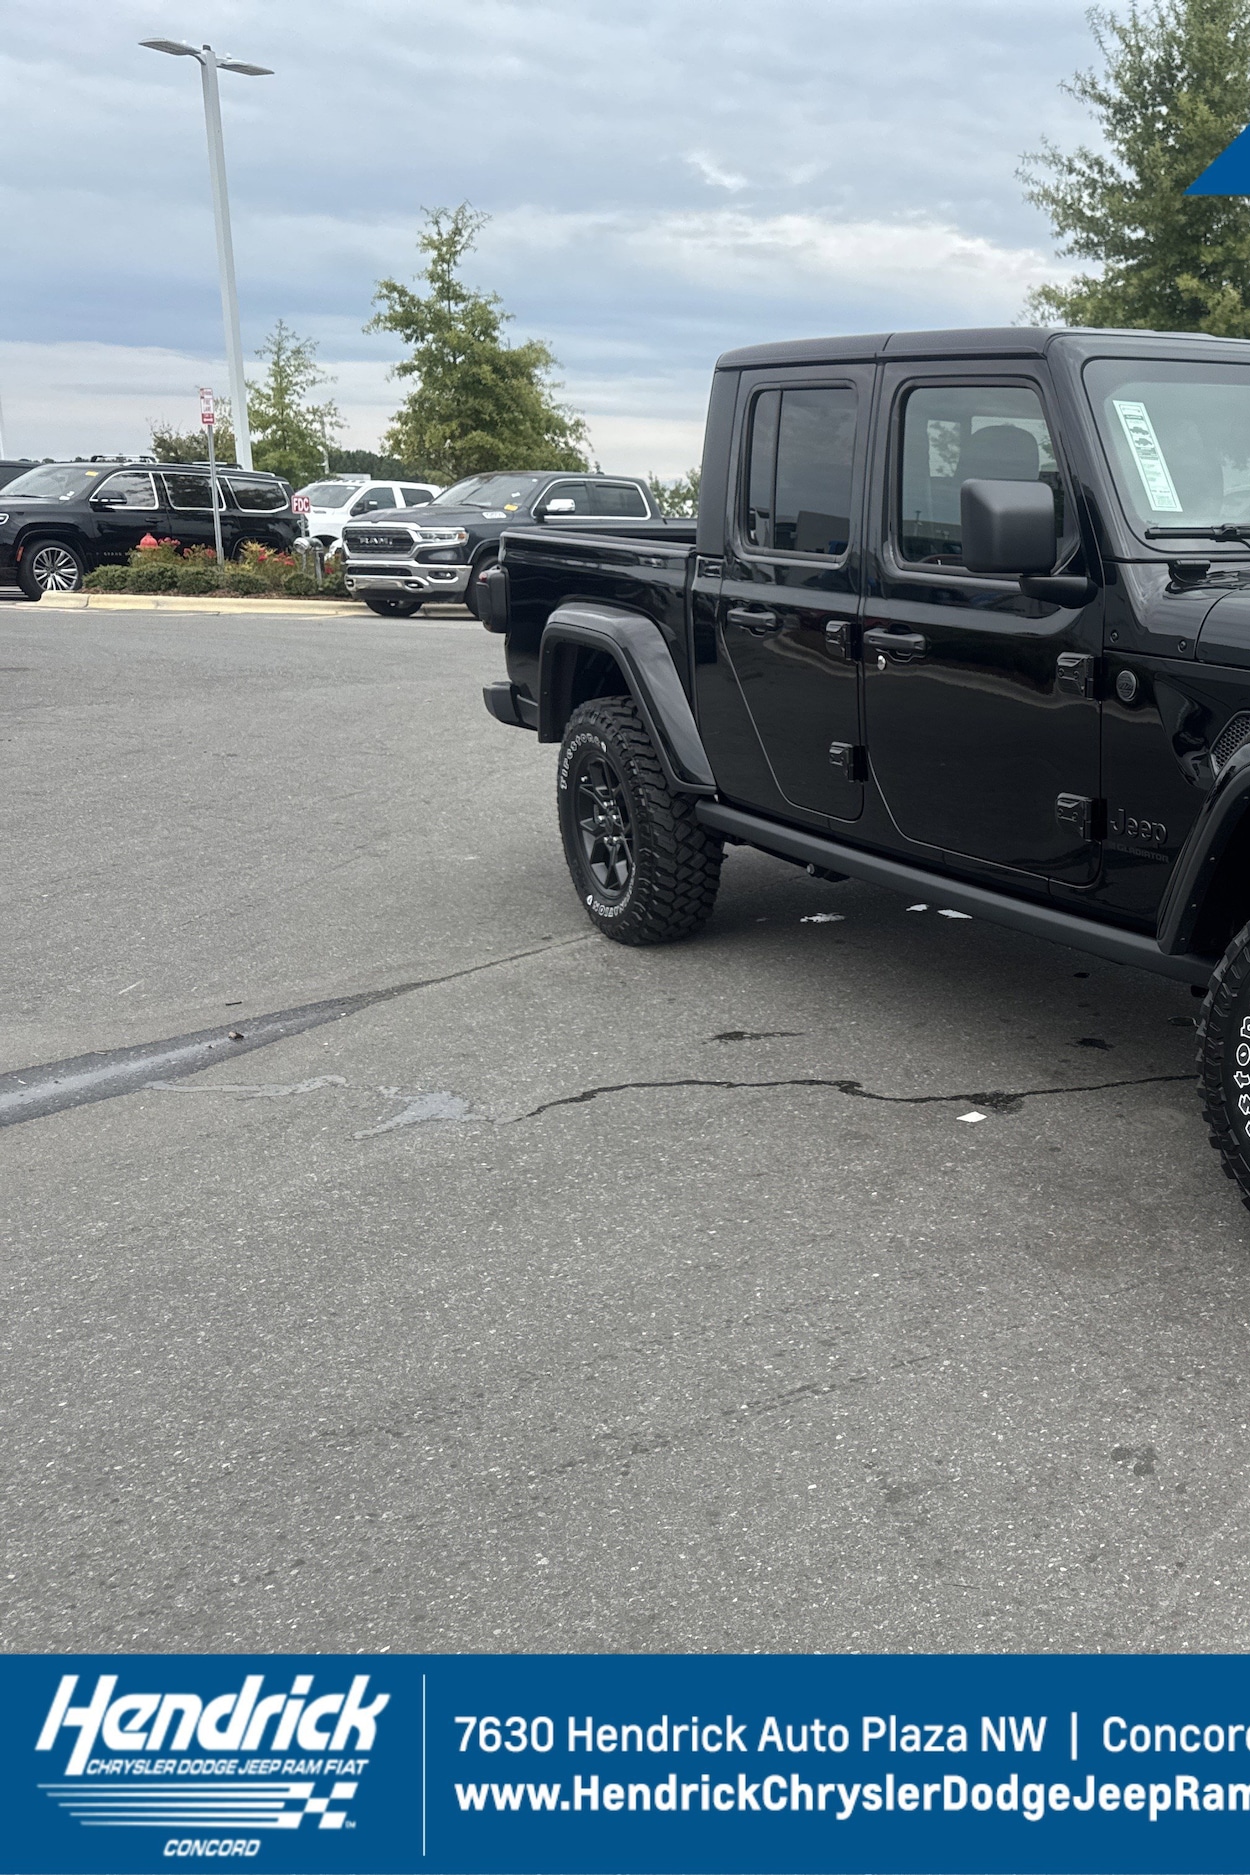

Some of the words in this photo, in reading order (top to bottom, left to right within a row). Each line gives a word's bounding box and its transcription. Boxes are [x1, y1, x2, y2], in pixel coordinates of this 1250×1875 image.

[293, 497, 309, 512] FDC
[359, 537, 389, 545] RAM
[1109, 808, 1168, 848] Jeep
